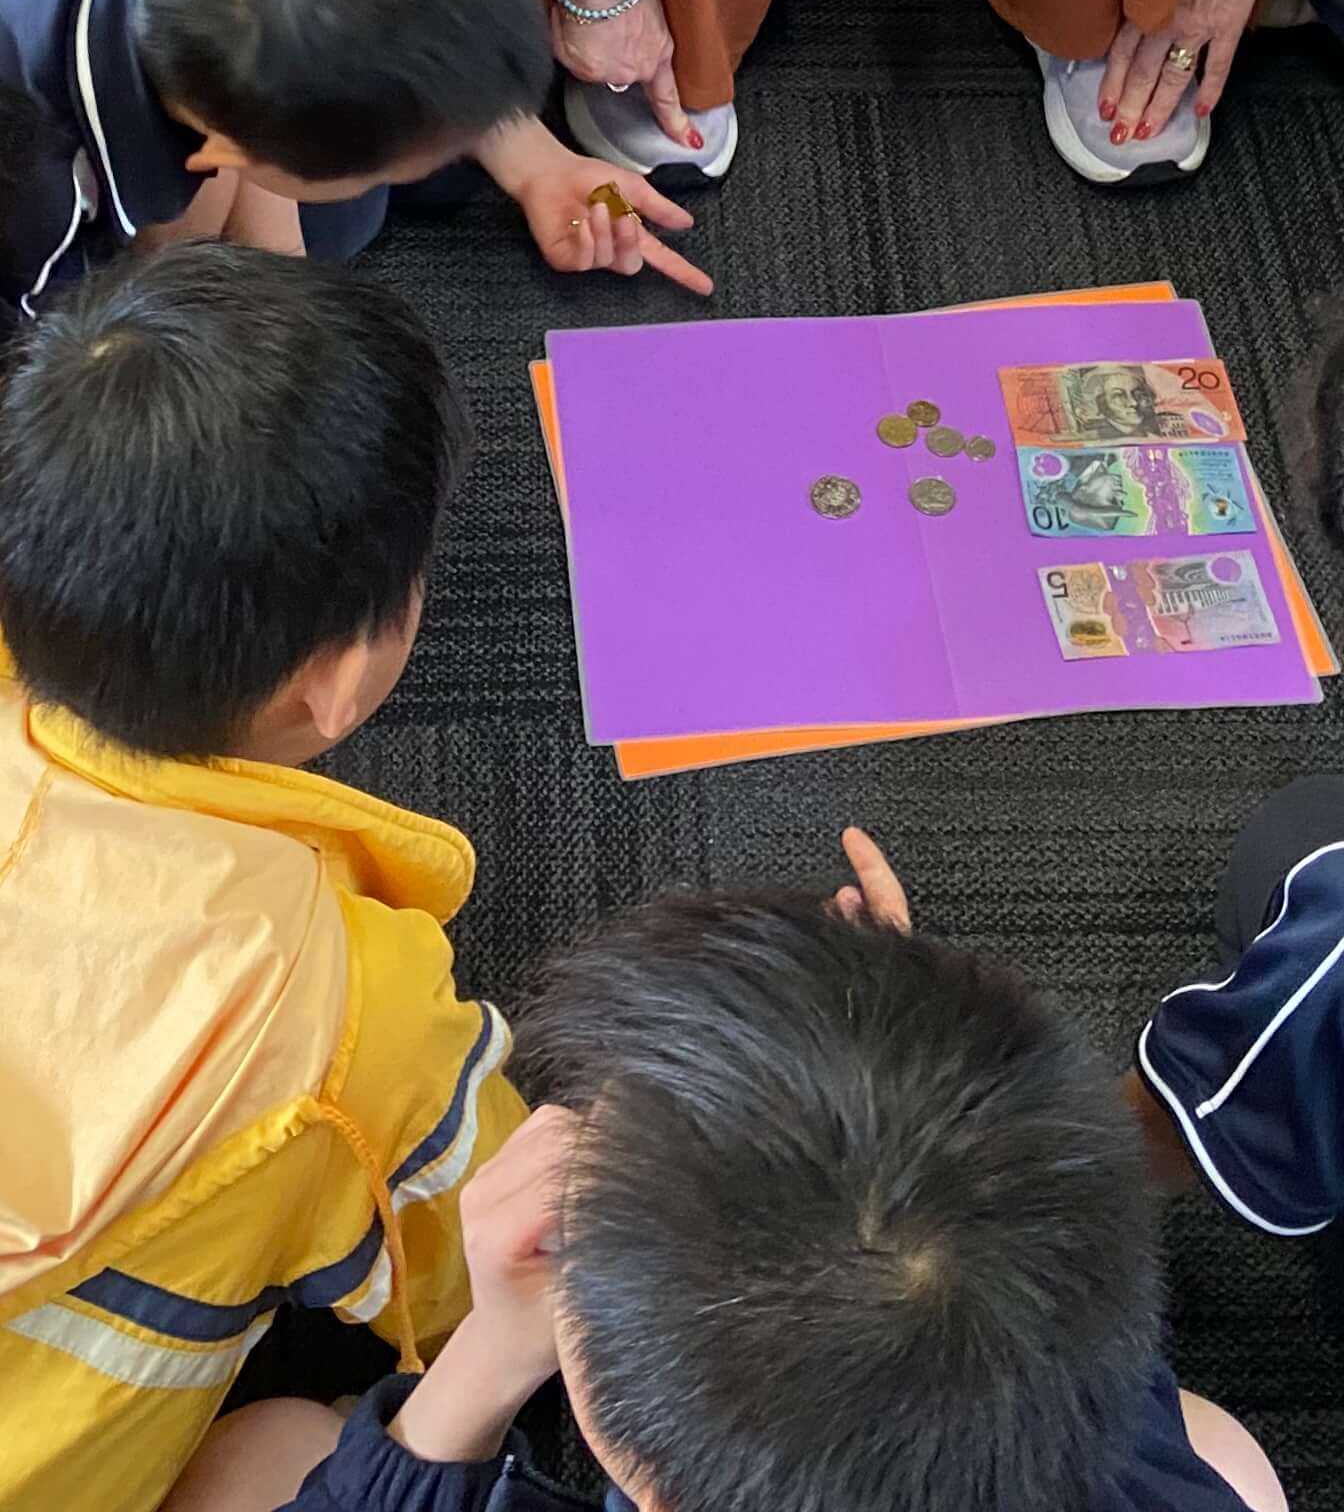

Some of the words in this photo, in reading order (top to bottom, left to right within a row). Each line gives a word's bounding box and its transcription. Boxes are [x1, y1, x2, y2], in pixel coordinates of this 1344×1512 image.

[1178, 367, 1220, 389] 20
[1032, 506, 1070, 531] 10
[1047, 571, 1068, 599] 5
